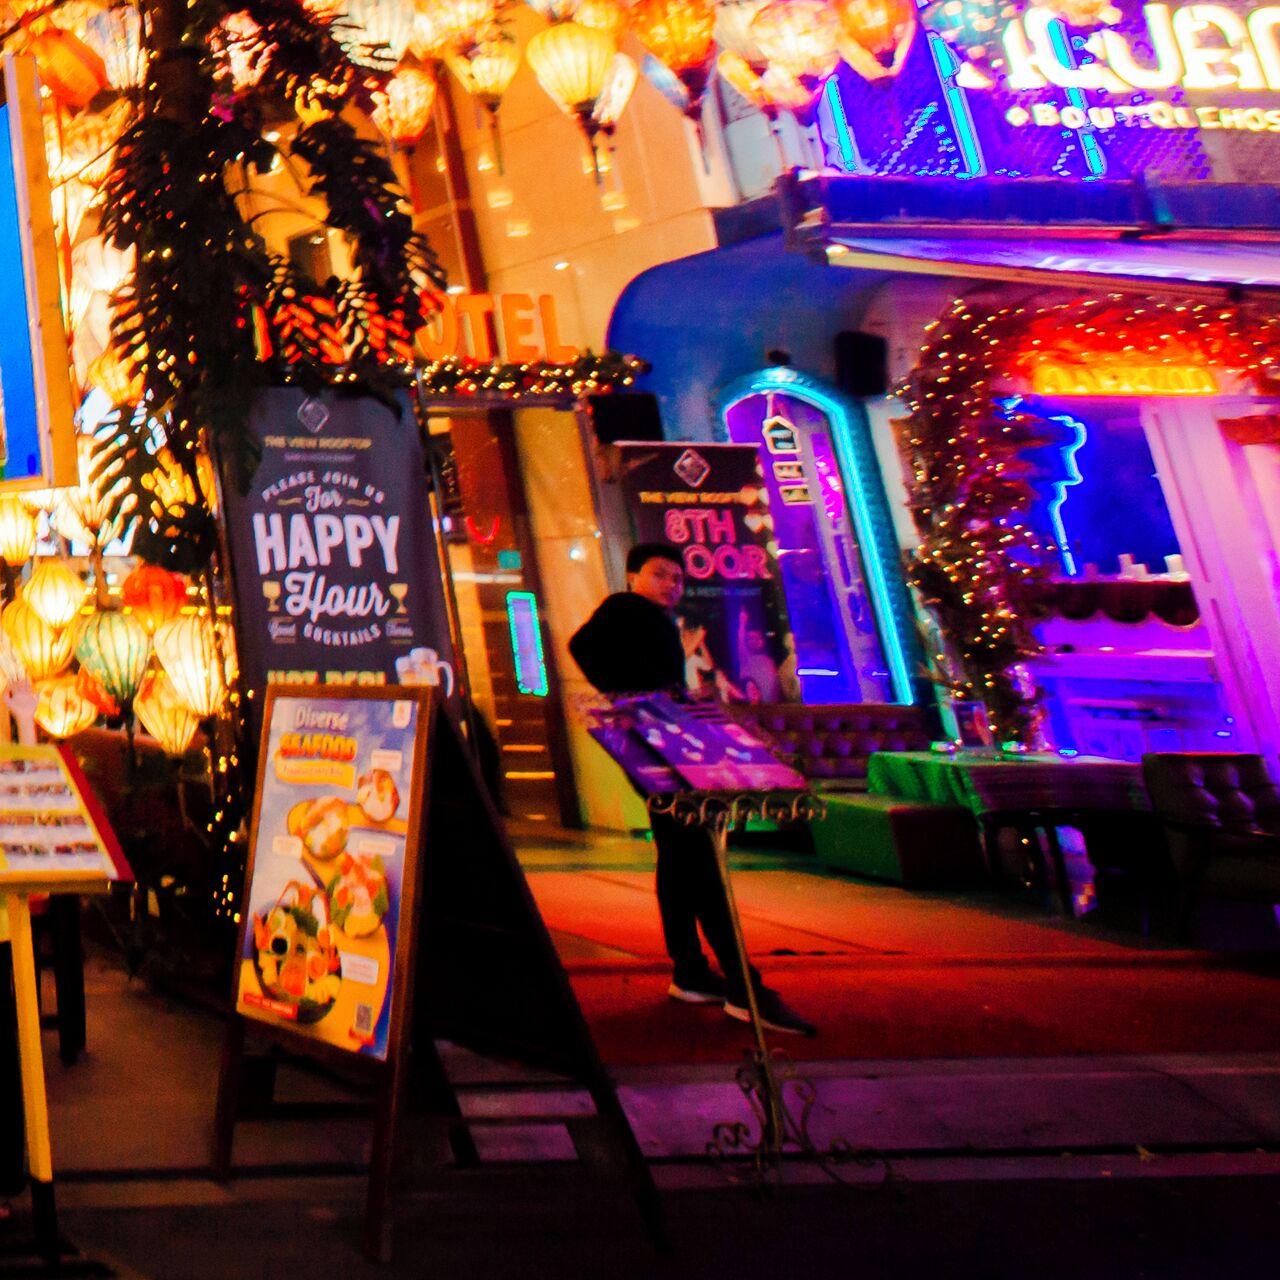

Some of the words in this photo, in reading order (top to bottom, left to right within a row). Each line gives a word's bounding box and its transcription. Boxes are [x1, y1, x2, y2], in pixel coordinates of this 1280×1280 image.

[416, 293, 580, 365] OTEL
[261, 471, 315, 503] PLEASE
[322, 471, 360, 490] JOIN
[304, 485, 344, 513] For
[252, 512, 401, 576] HAPPY
[664, 507, 737, 544] 8TH
[683, 543, 774, 580] OOR
[284, 570, 391, 623] Hour
[279, 732, 358, 763] SEAFOOD
